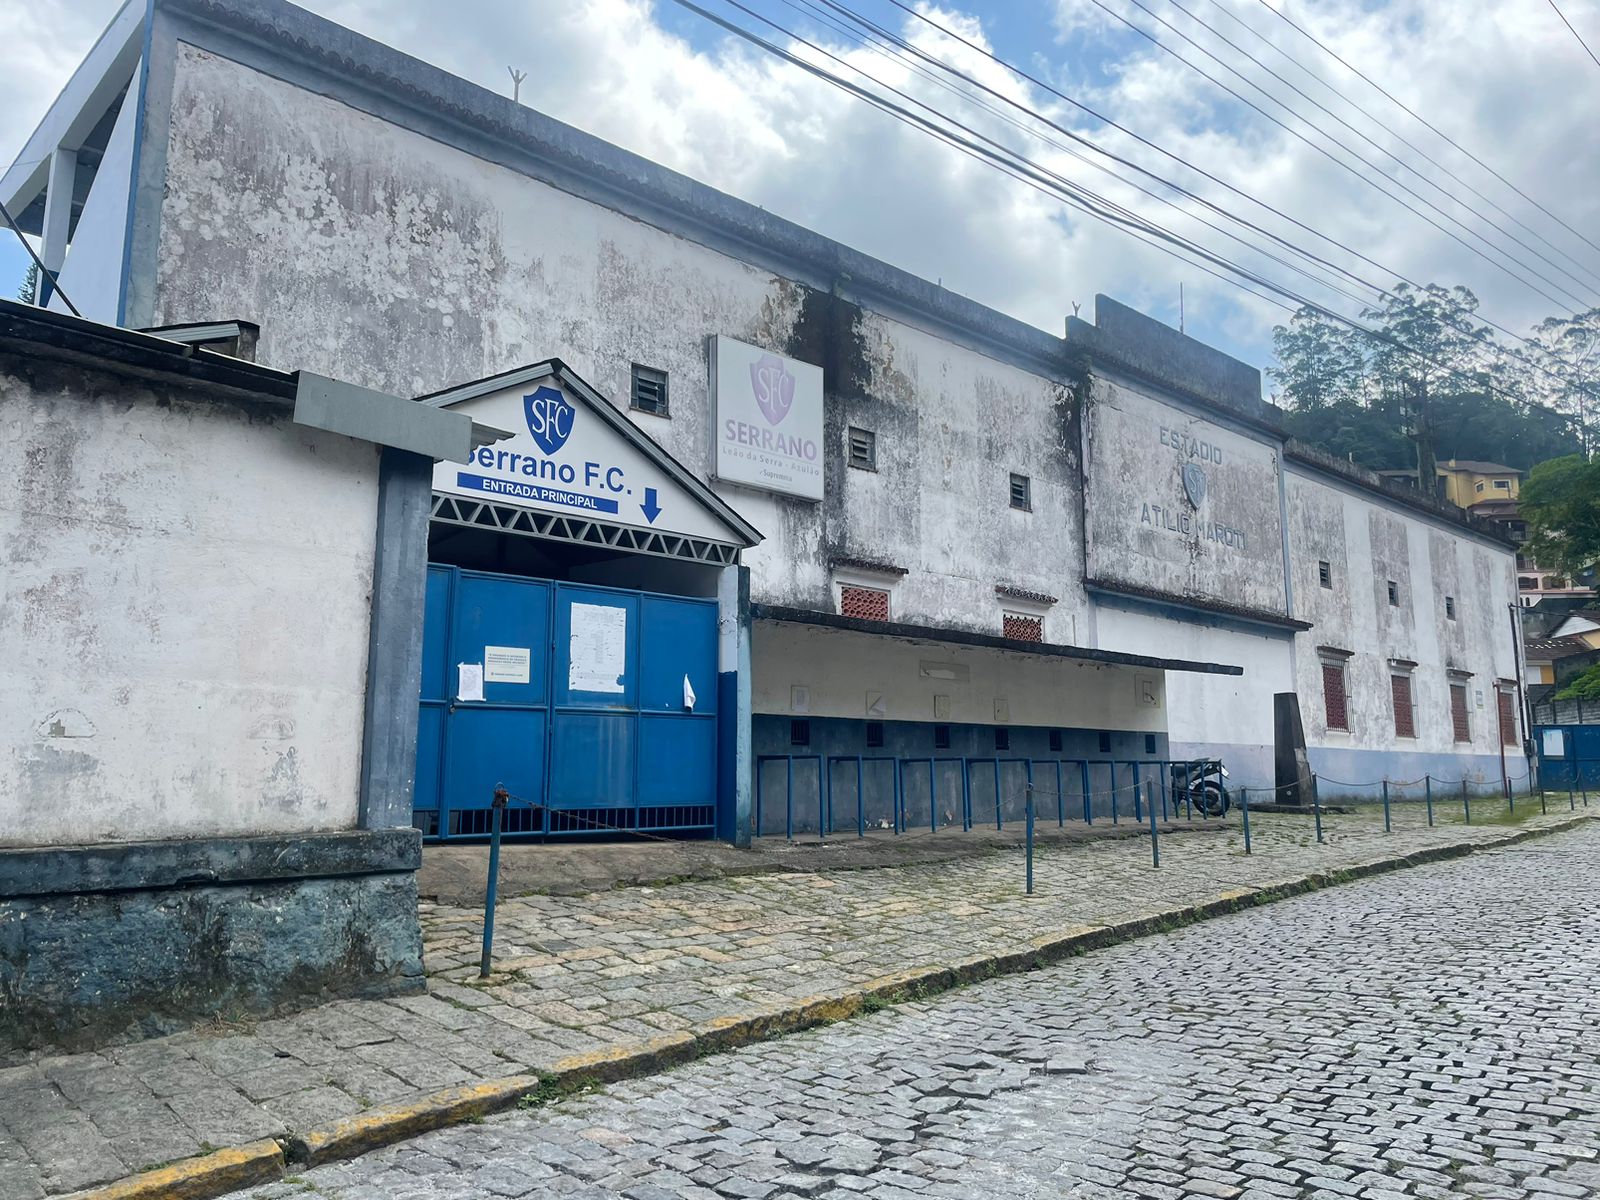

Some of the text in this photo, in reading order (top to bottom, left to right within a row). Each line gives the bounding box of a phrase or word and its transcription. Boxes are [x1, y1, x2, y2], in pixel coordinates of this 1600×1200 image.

[758, 368, 790, 413] SFC
[531, 398, 568, 445] SFC
[725, 419, 817, 461] SERRANO
[722, 446, 744, 458] Leão
[747, 451, 757, 461] da
[760, 455, 783, 467] Serra
[1160, 427, 1222, 464] ESTADIO
[469, 447, 632, 495] errano F.C.
[482, 480, 597, 509] ENTRADA PRINCIPAL
[1141, 503, 1190, 534] ATILIO
